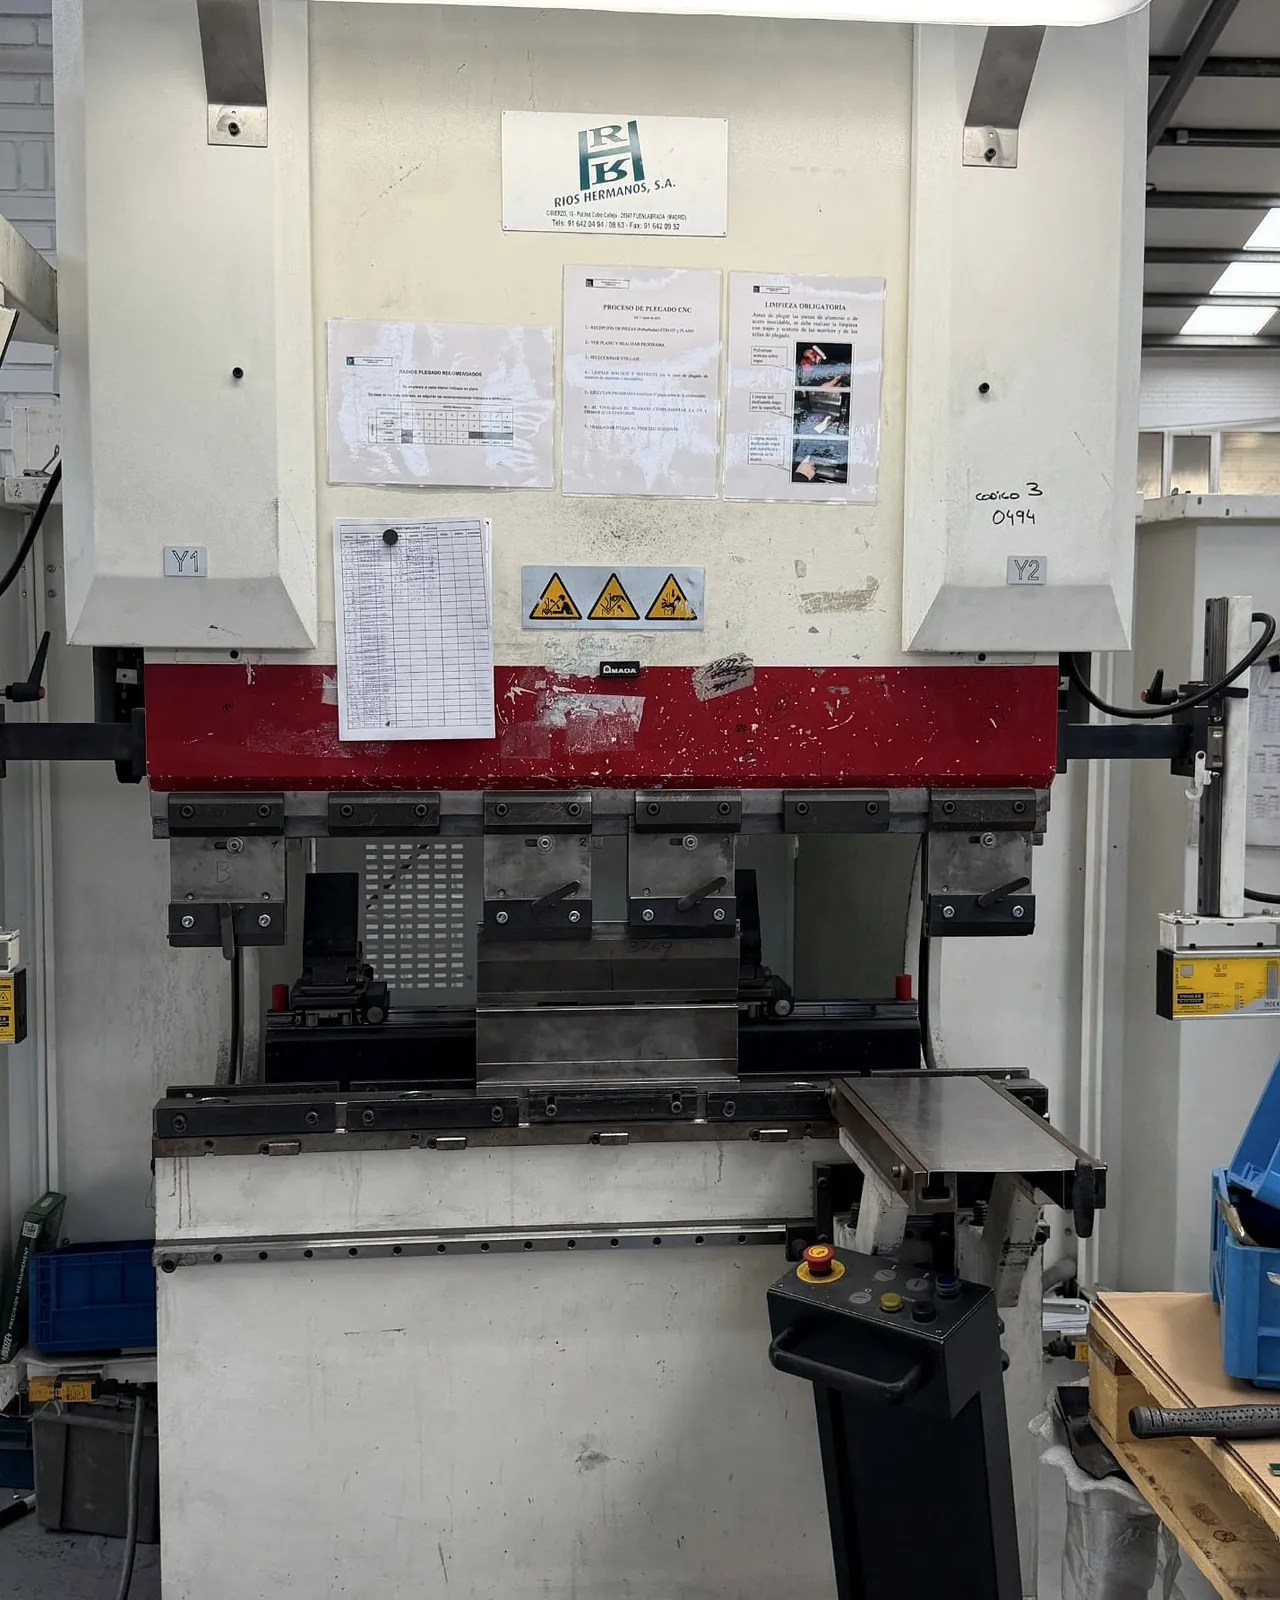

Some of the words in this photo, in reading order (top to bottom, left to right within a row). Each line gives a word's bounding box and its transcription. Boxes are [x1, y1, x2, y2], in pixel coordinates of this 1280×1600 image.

[554, 194, 580, 207] RIOS
[584, 183, 650, 202] HERMANOS,
[654, 178, 676, 190] S.A.
[576, 220, 587, 228] 642
[588, 220, 596, 228] 04
[630, 222, 642, 230] Fax:
[644, 222, 651, 230] 91
[652, 222, 664, 230] 642
[603, 304, 634, 312] PROCESO
[765, 301, 798, 309] LIMPIEZA
[800, 302, 846, 310] OBLIGATORIA
[1026, 482, 1043, 496] 3
[992, 508, 1036, 526] 0494
[172, 550, 198, 572] Y1
[1014, 559, 1040, 580] Y2
[603, 664, 637, 674] AMADA
[8, 1296, 20, 1330] PRECISION
[16, 1246, 30, 1294] MEASUREMENT
